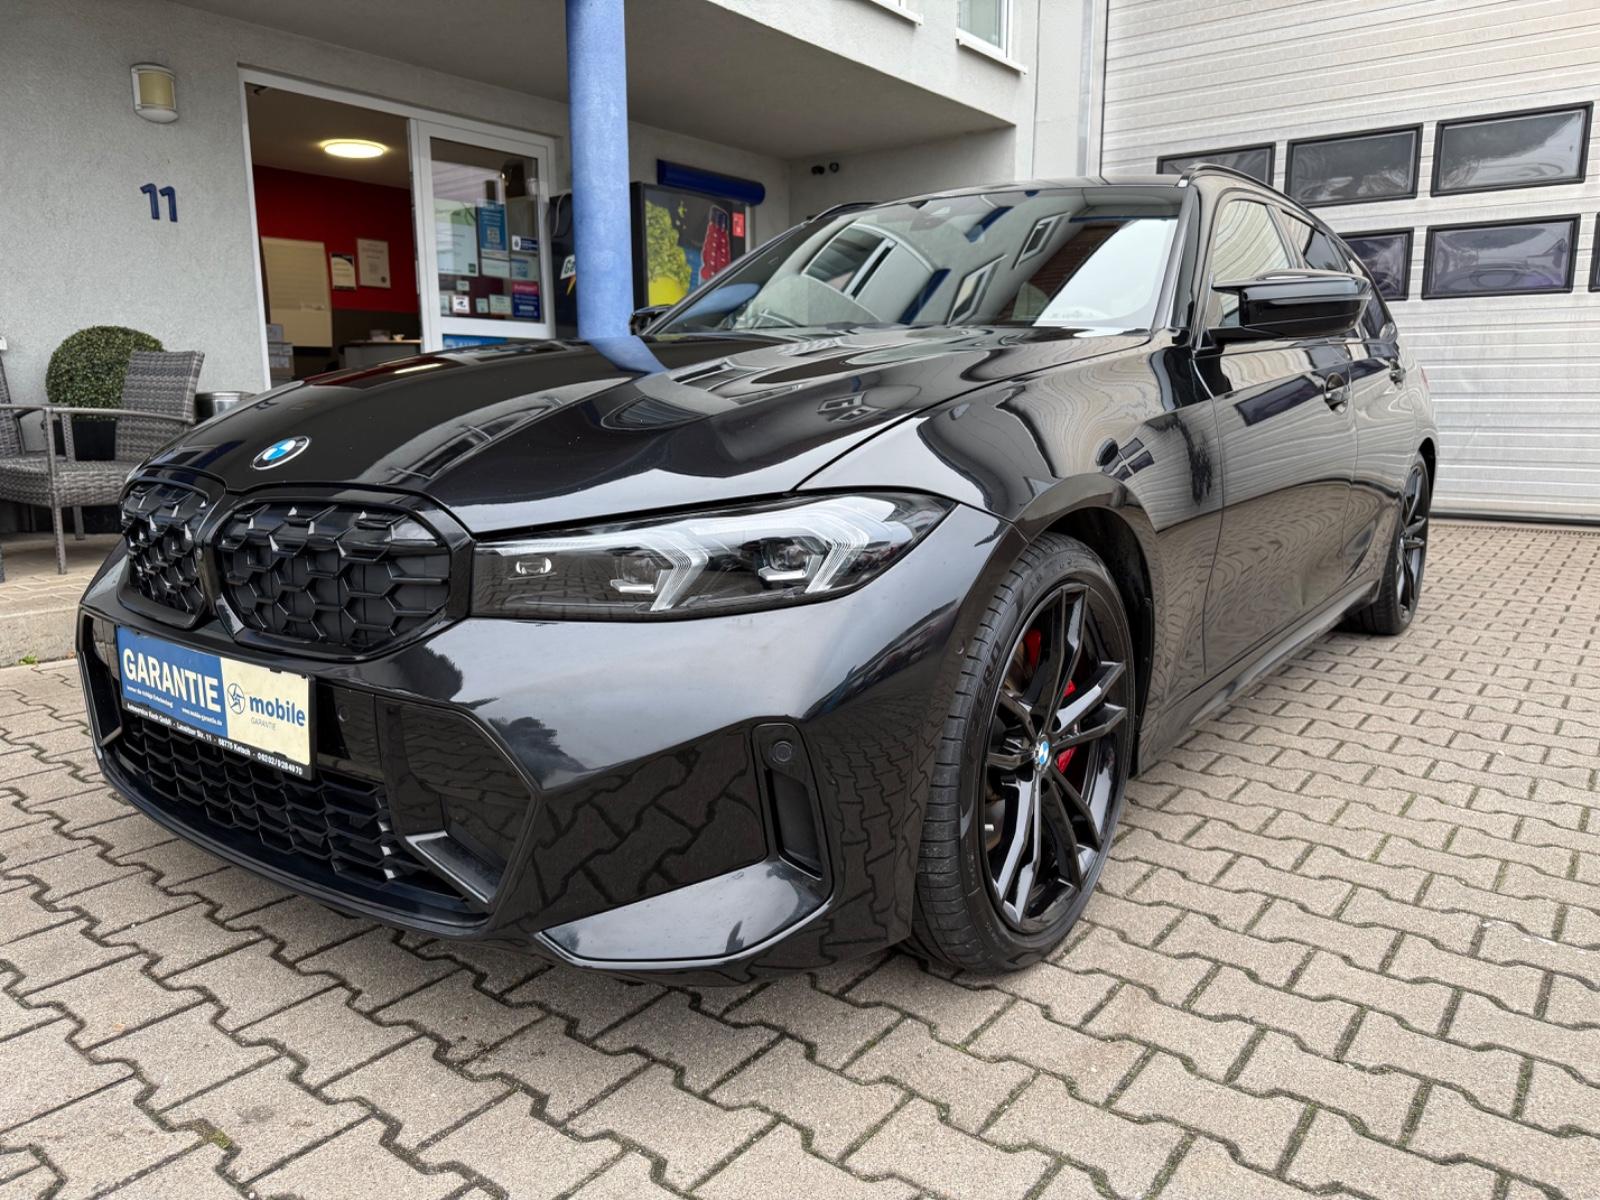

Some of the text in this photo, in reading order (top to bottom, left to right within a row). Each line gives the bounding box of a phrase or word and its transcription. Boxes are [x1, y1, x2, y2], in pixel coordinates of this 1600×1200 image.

[140, 183, 178, 223] 11
[123, 648, 221, 713] GARANTIE
[249, 696, 306, 727] mobile
